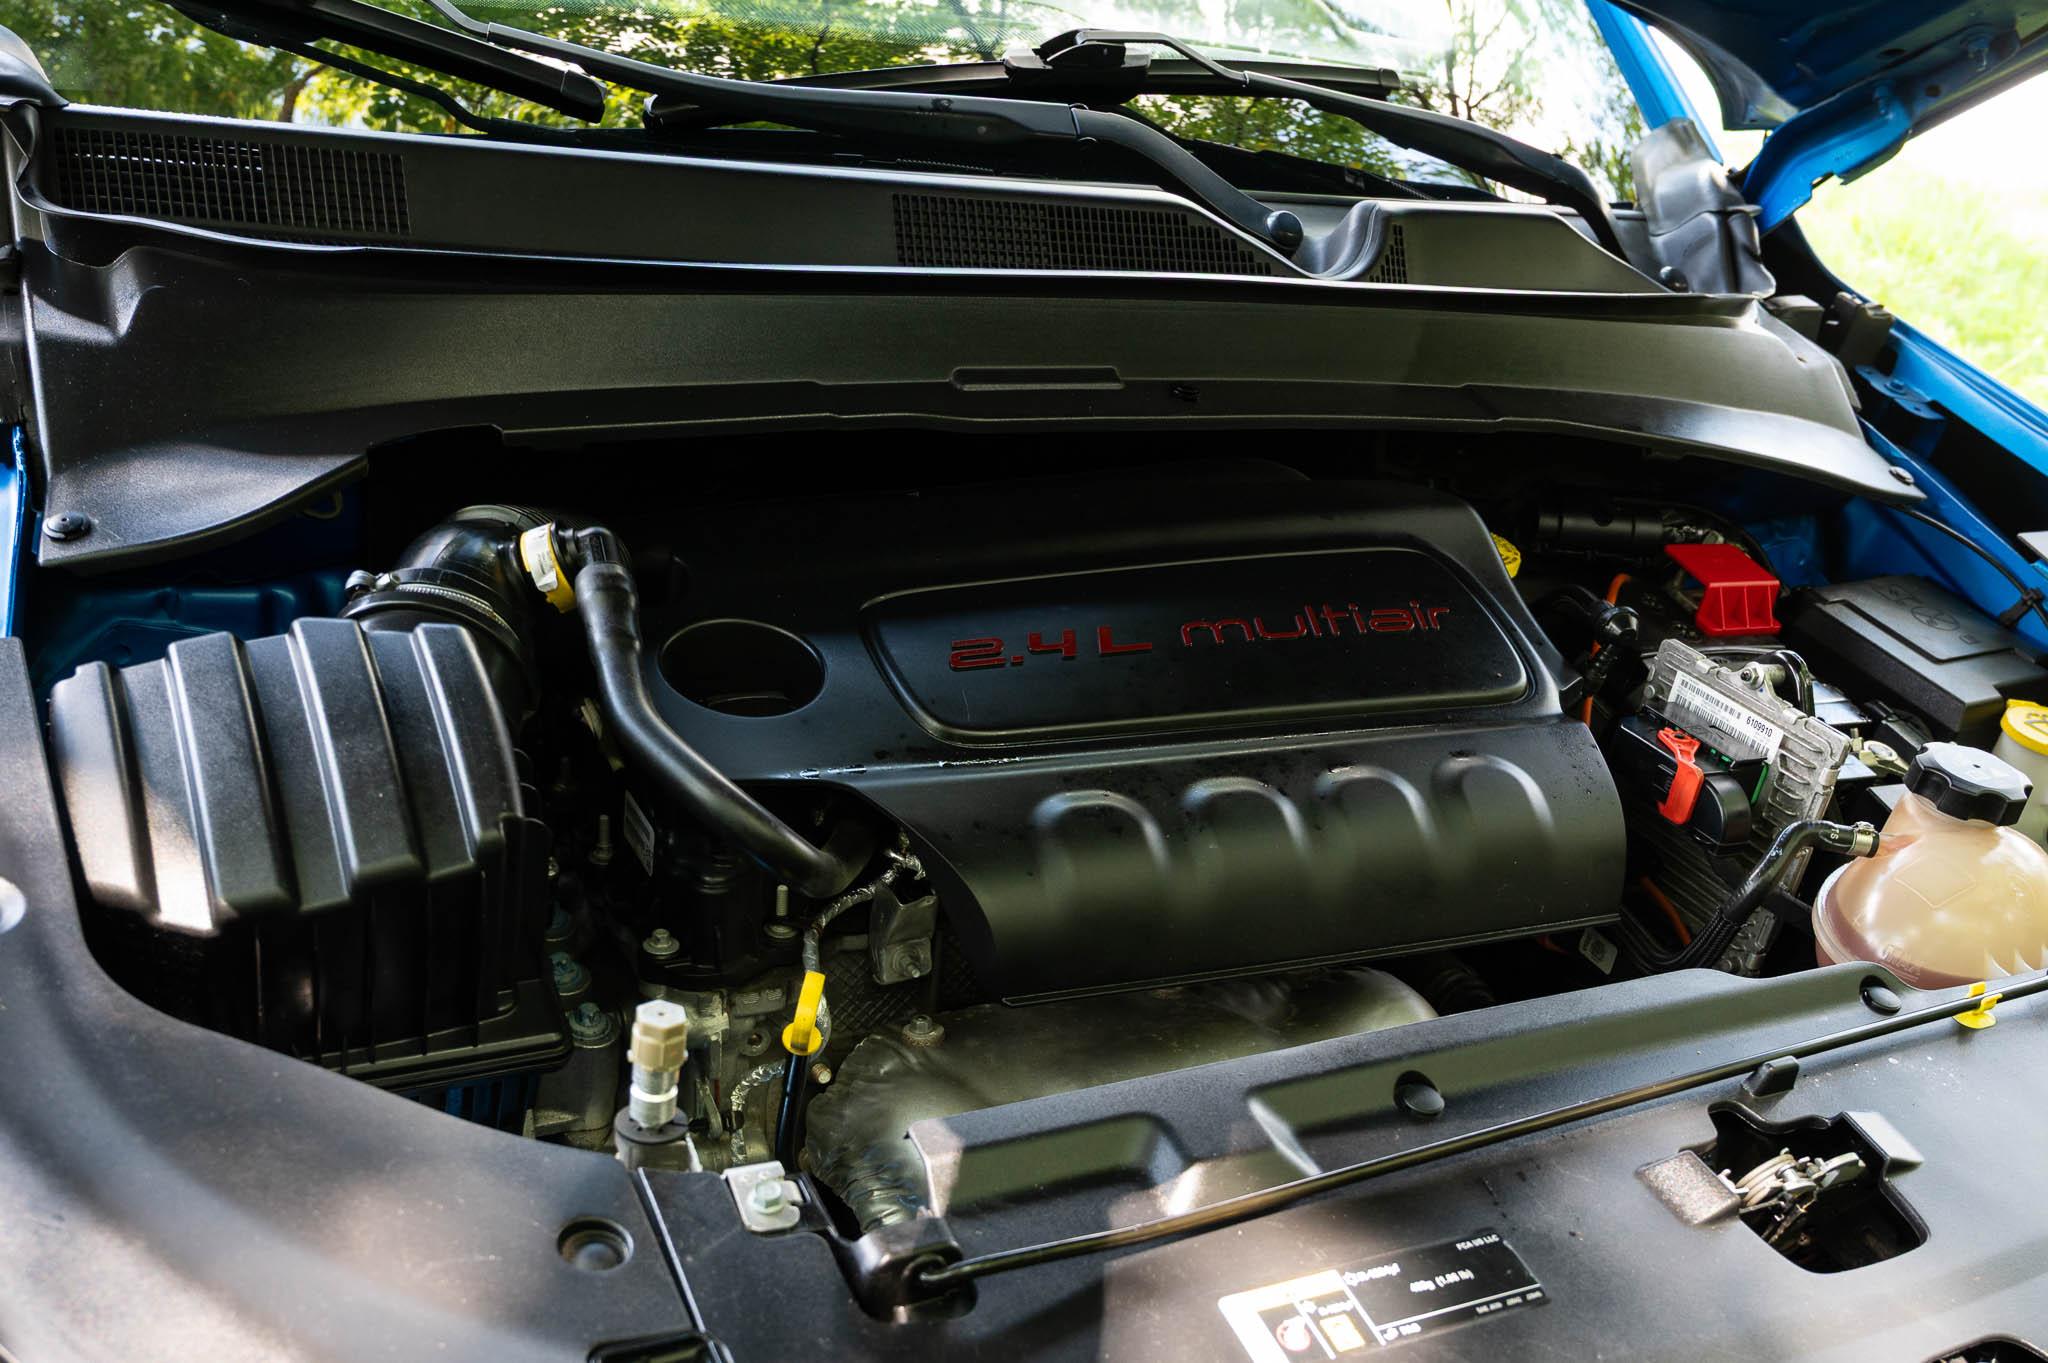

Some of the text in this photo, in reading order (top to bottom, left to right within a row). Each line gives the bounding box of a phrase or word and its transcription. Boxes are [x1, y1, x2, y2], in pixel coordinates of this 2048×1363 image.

[949, 600, 1450, 671] 2.4 L multiair
[1747, 716, 1773, 737] 6109910
[1483, 1234, 1500, 1244] LLC
